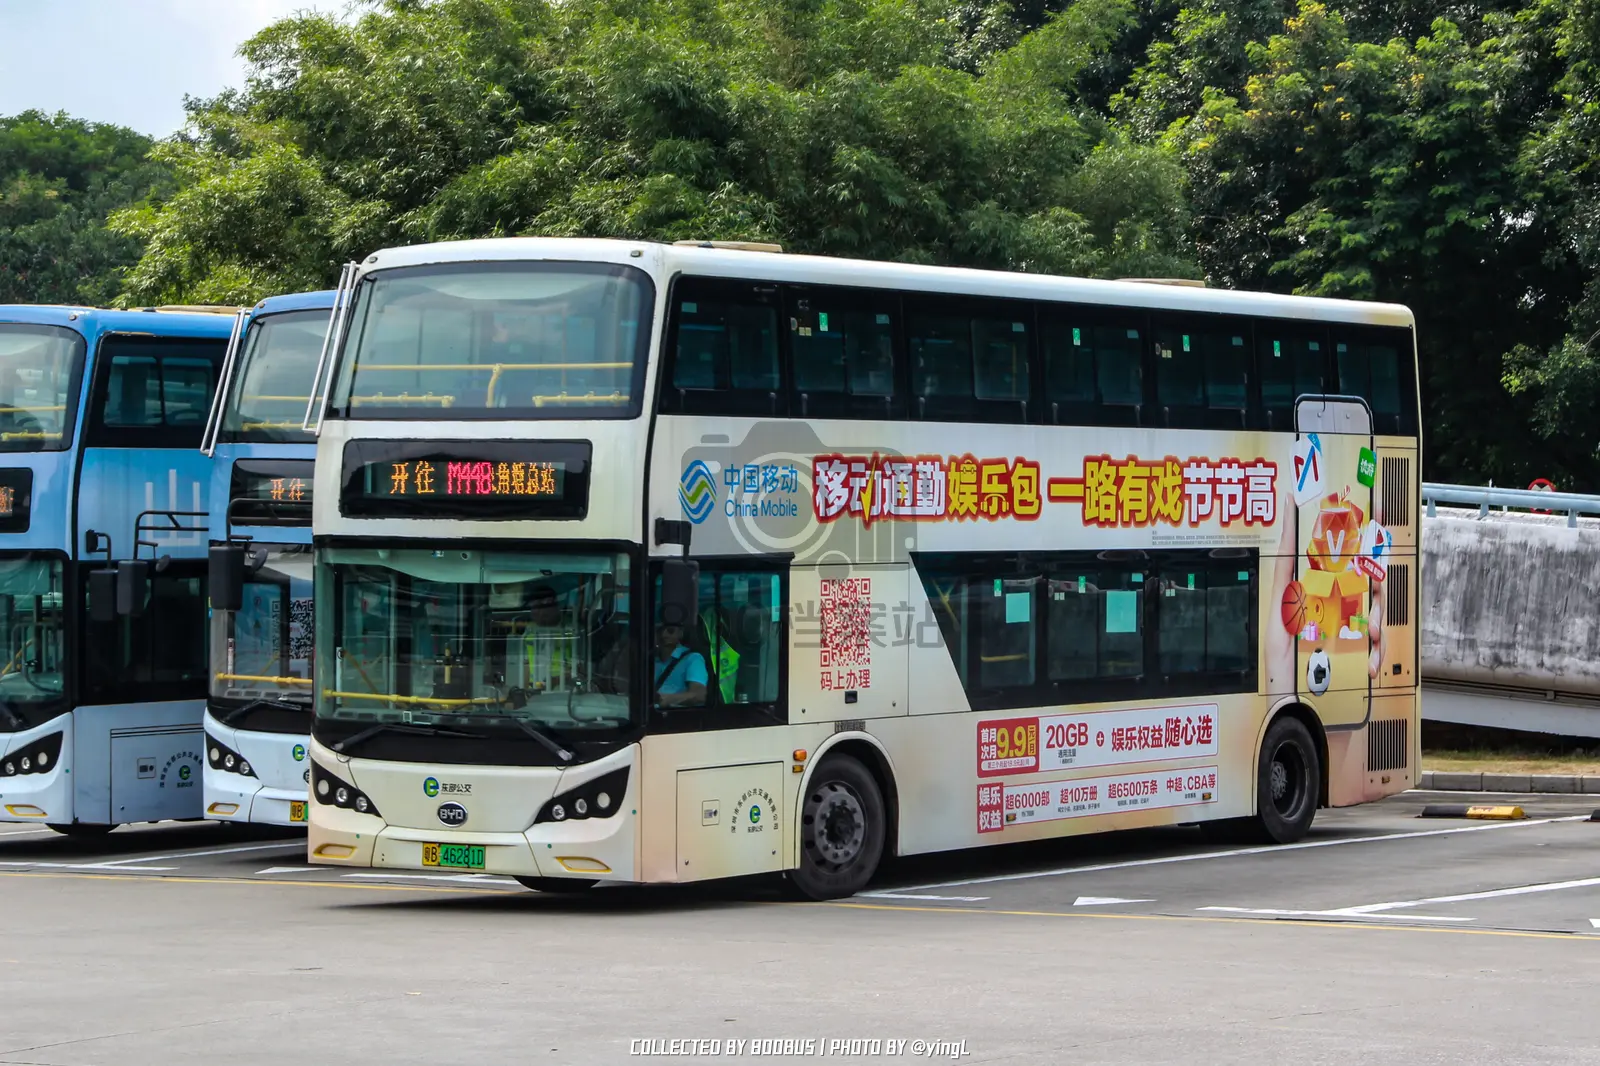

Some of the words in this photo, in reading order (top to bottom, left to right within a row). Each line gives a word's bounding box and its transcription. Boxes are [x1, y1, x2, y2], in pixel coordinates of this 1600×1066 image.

[391, 461, 435, 493] 开往
[724, 464, 798, 494] 中国移动
[813, 457, 1041, 518] 移动通勤娱乐包
[1049, 459, 1277, 523] 一路有戏节节高
[724, 499, 759, 517] China
[761, 499, 798, 517] Mobile
[820, 669, 870, 691] 码上办理
[981, 728, 997, 744] 首月
[997, 726, 1027, 758] 9.9
[1046, 723, 1088, 748] 20GB
[1111, 714, 1213, 752] 娱乐权益随心选
[981, 745, 997, 760] 次月
[441, 783, 472, 793] 东部公交
[979, 786, 1001, 806] 娱乐
[1060, 785, 1098, 804] 超10万册
[1108, 779, 1158, 799] 超6500万条
[1005, 791, 1050, 810] 超6000部
[440, 808, 464, 820] BYD
[979, 810, 1002, 830] 权益
[443, 847, 484, 866] 46281D
